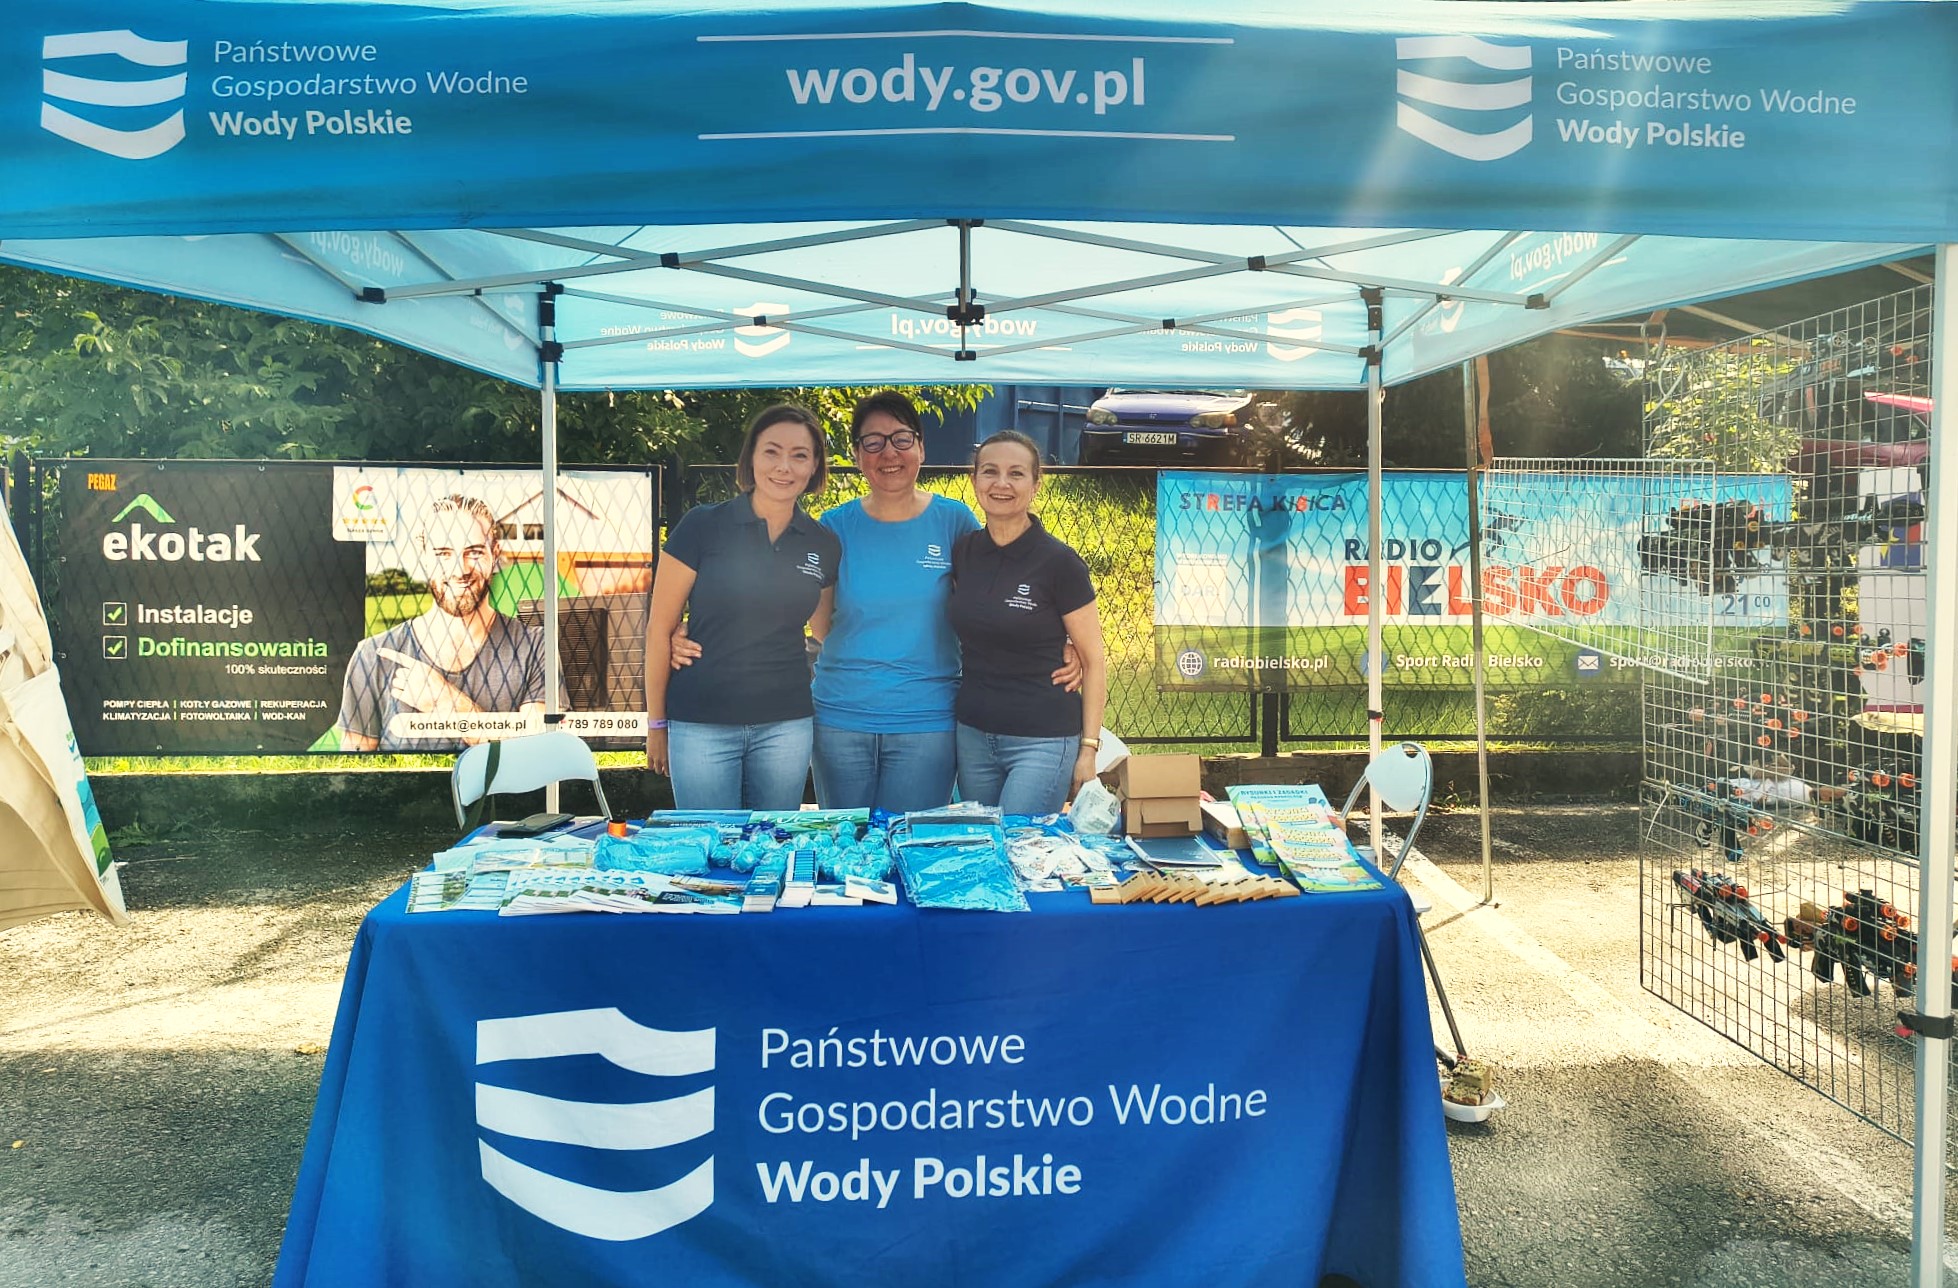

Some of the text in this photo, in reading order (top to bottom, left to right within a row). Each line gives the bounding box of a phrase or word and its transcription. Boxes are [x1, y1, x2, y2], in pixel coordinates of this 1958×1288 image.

[214, 39, 377, 63] Państwowe
[1557, 47, 1712, 74] Państwowe
[211, 71, 528, 101] Gospodarstwo Wodne
[786, 53, 1146, 115] wody.gov.pl
[1556, 82, 1857, 114] Gospodarstwo Wodne
[210, 108, 412, 140] Wody Polskie
[1556, 119, 1745, 149] Wody Polskie
[1128, 433, 1175, 444] SR 6621M
[87, 473, 117, 491] PEGAZ
[1179, 492, 1346, 512] STREFA KIBICA
[103, 523, 262, 562] ekotak
[1344, 565, 1610, 616] BIELSKO
[138, 603, 253, 628] Instalacje
[138, 637, 328, 657] Dofinansowania
[225, 664, 327, 675] 100% skuteczności
[1213, 655, 1328, 672] radiobielsko.pl
[1396, 654, 1543, 670] Sport Radi Bielsko
[103, 700, 327, 709] POMPY CIEPŁA KOTŁY GAZOWE REKUPERACJA
[103, 712, 306, 721] KLIMATYZACJA FOTOWOLTAIKA WOD-KAN
[409, 719, 638, 732] kontakt@ekotak.pl 789 789 080
[760, 1025, 1026, 1070] Państwowe
[758, 1082, 1269, 1140] Gospodarstwo Wodne
[757, 1153, 1082, 1210] Wody Polskie
